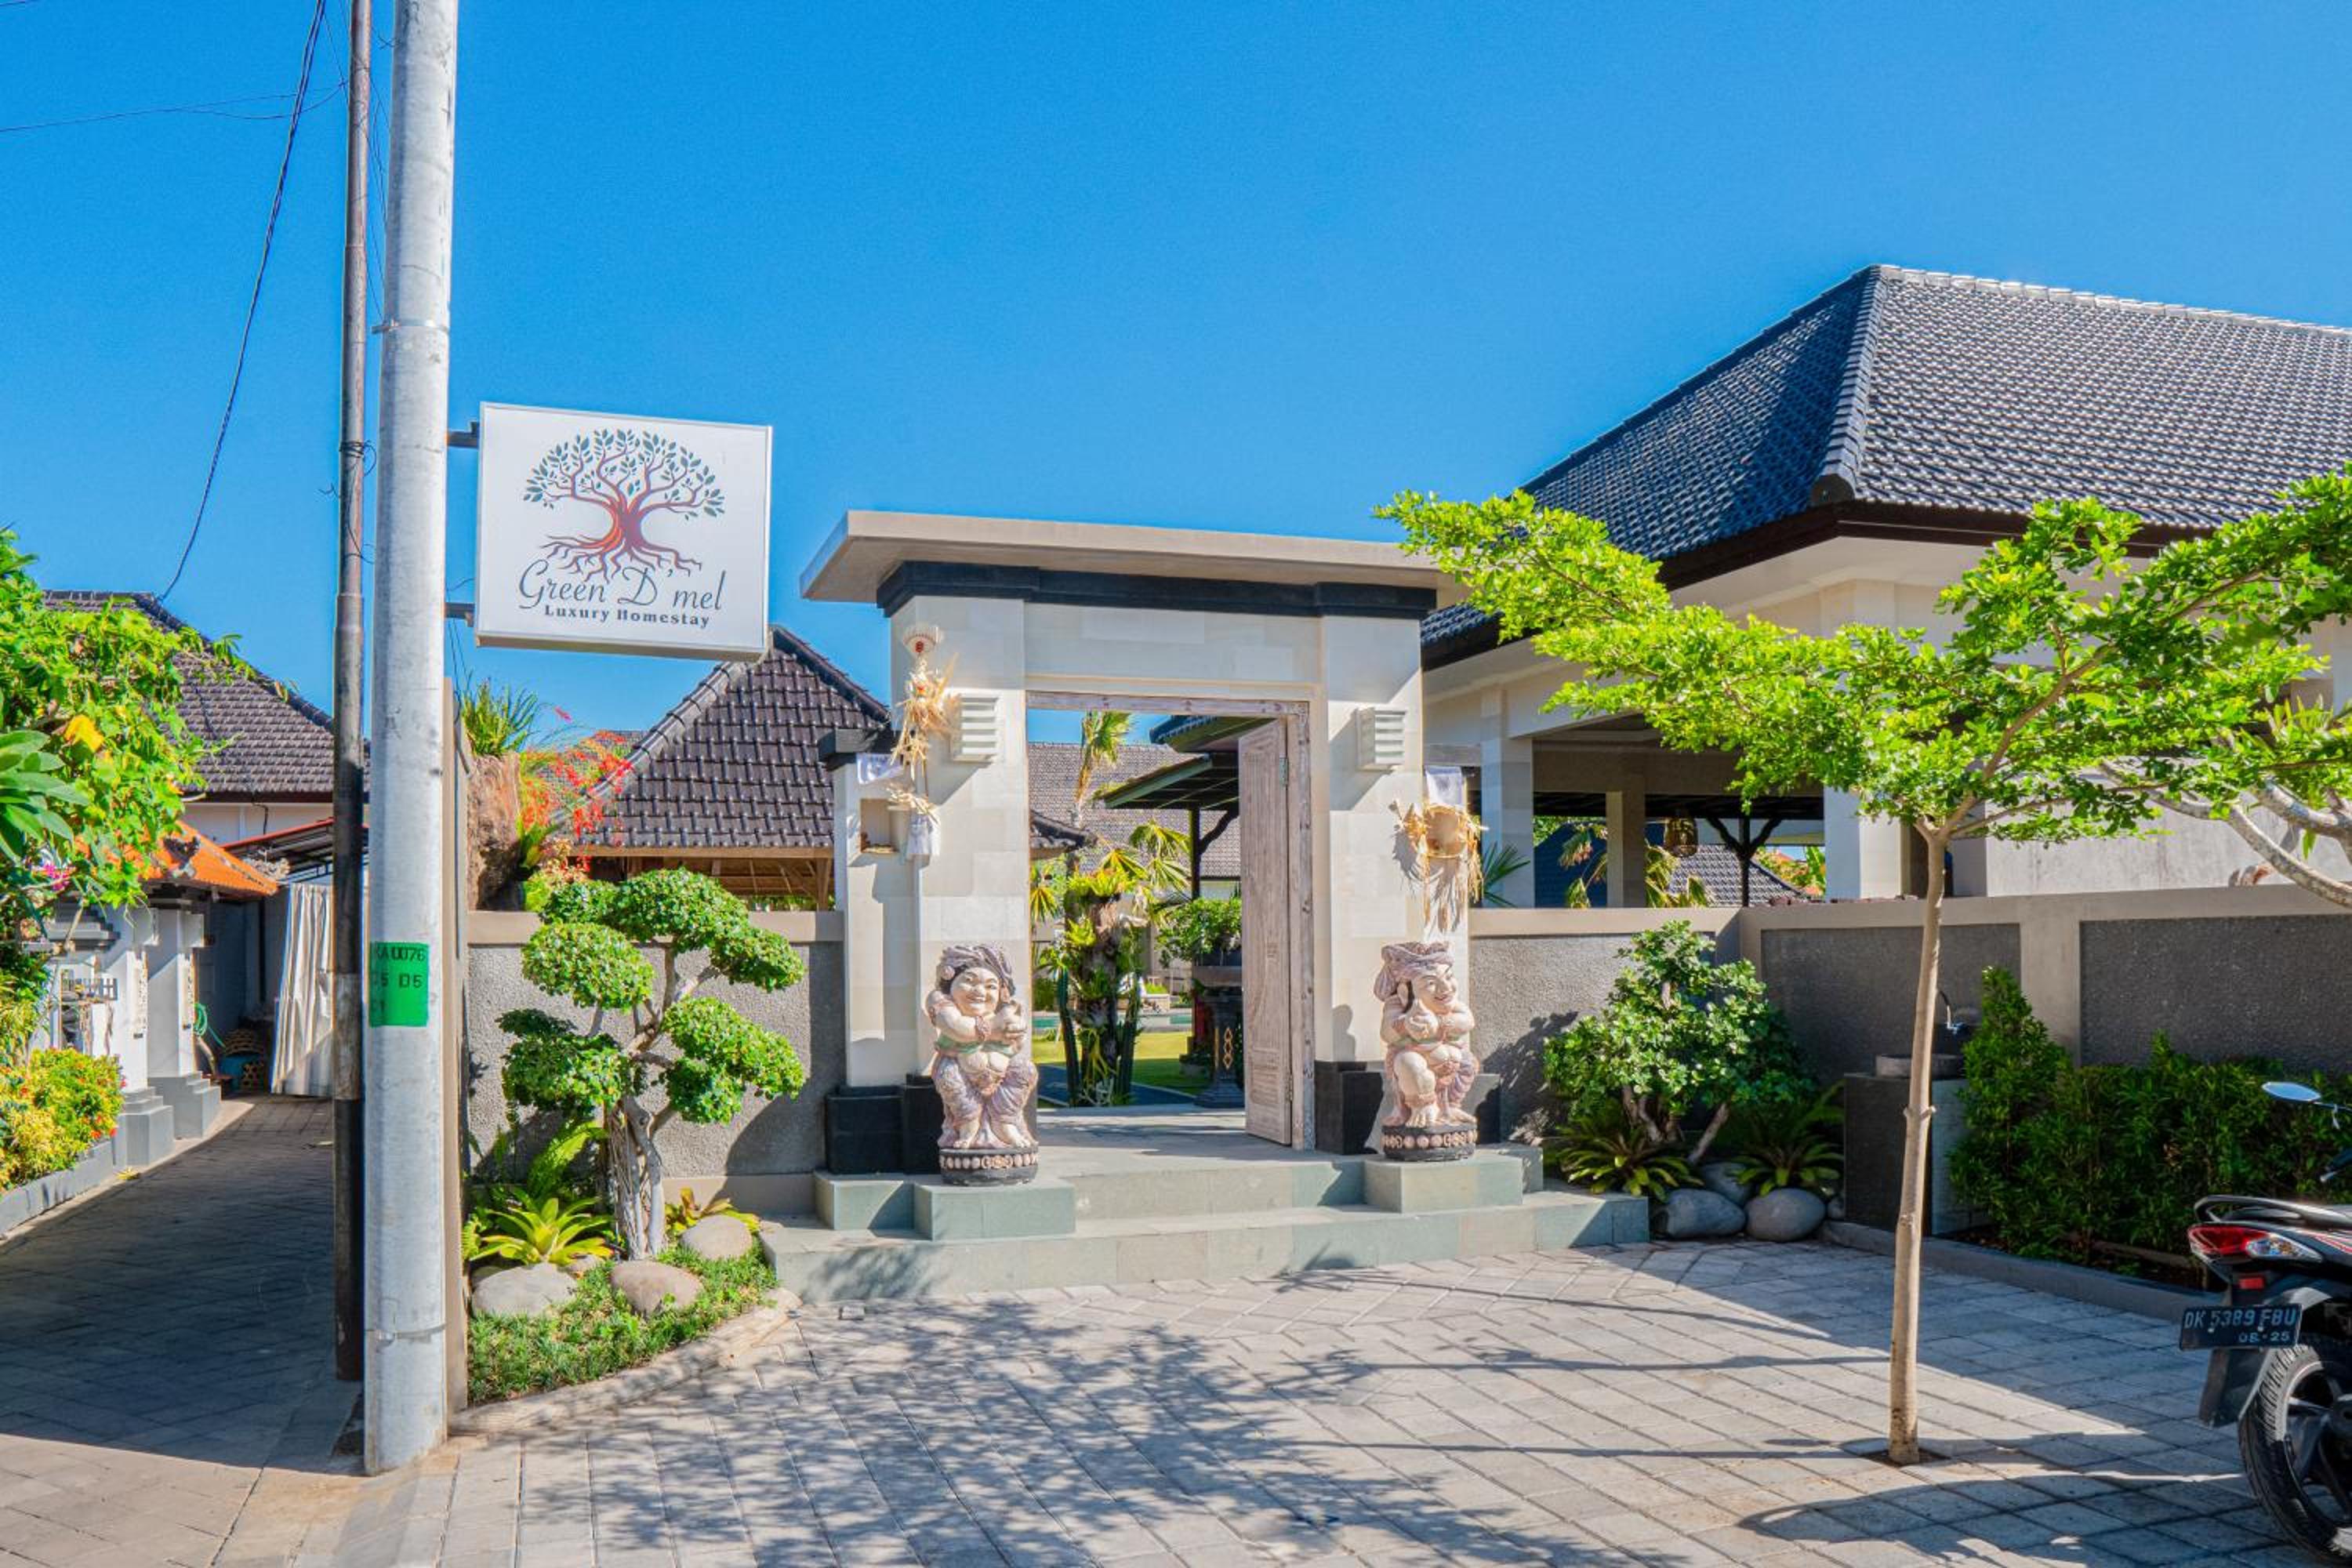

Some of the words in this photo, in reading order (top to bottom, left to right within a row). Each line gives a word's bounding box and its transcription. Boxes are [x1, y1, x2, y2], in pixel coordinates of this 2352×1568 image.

[518, 559, 606, 609] Green
[545, 604, 609, 622] Luxury
[617, 609, 710, 629] Homestay
[2183, 1311, 2205, 1329] DK
